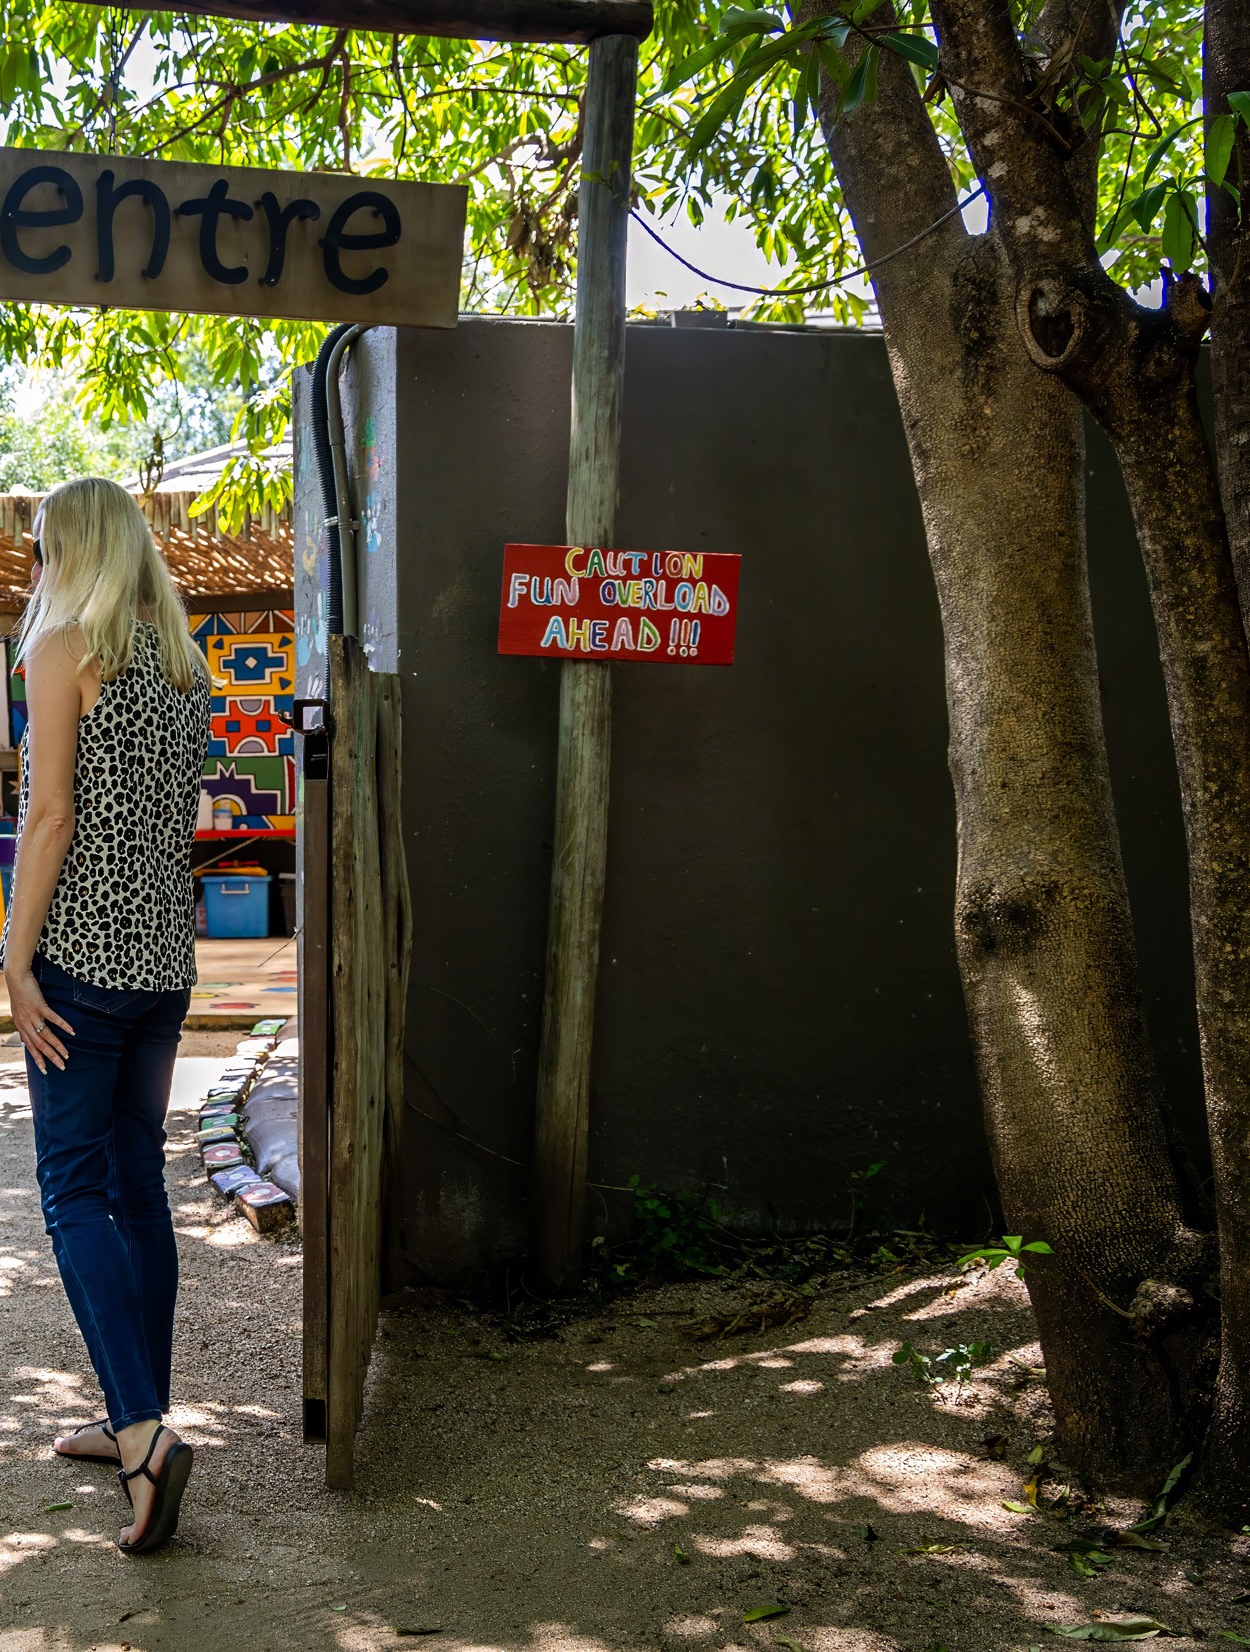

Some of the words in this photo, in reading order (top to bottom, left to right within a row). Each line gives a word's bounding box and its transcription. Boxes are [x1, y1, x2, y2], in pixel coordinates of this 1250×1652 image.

[565, 547, 703, 579] CAUTION
[507, 573, 579, 608] FUN
[600, 578, 730, 617] OVERLOAD
